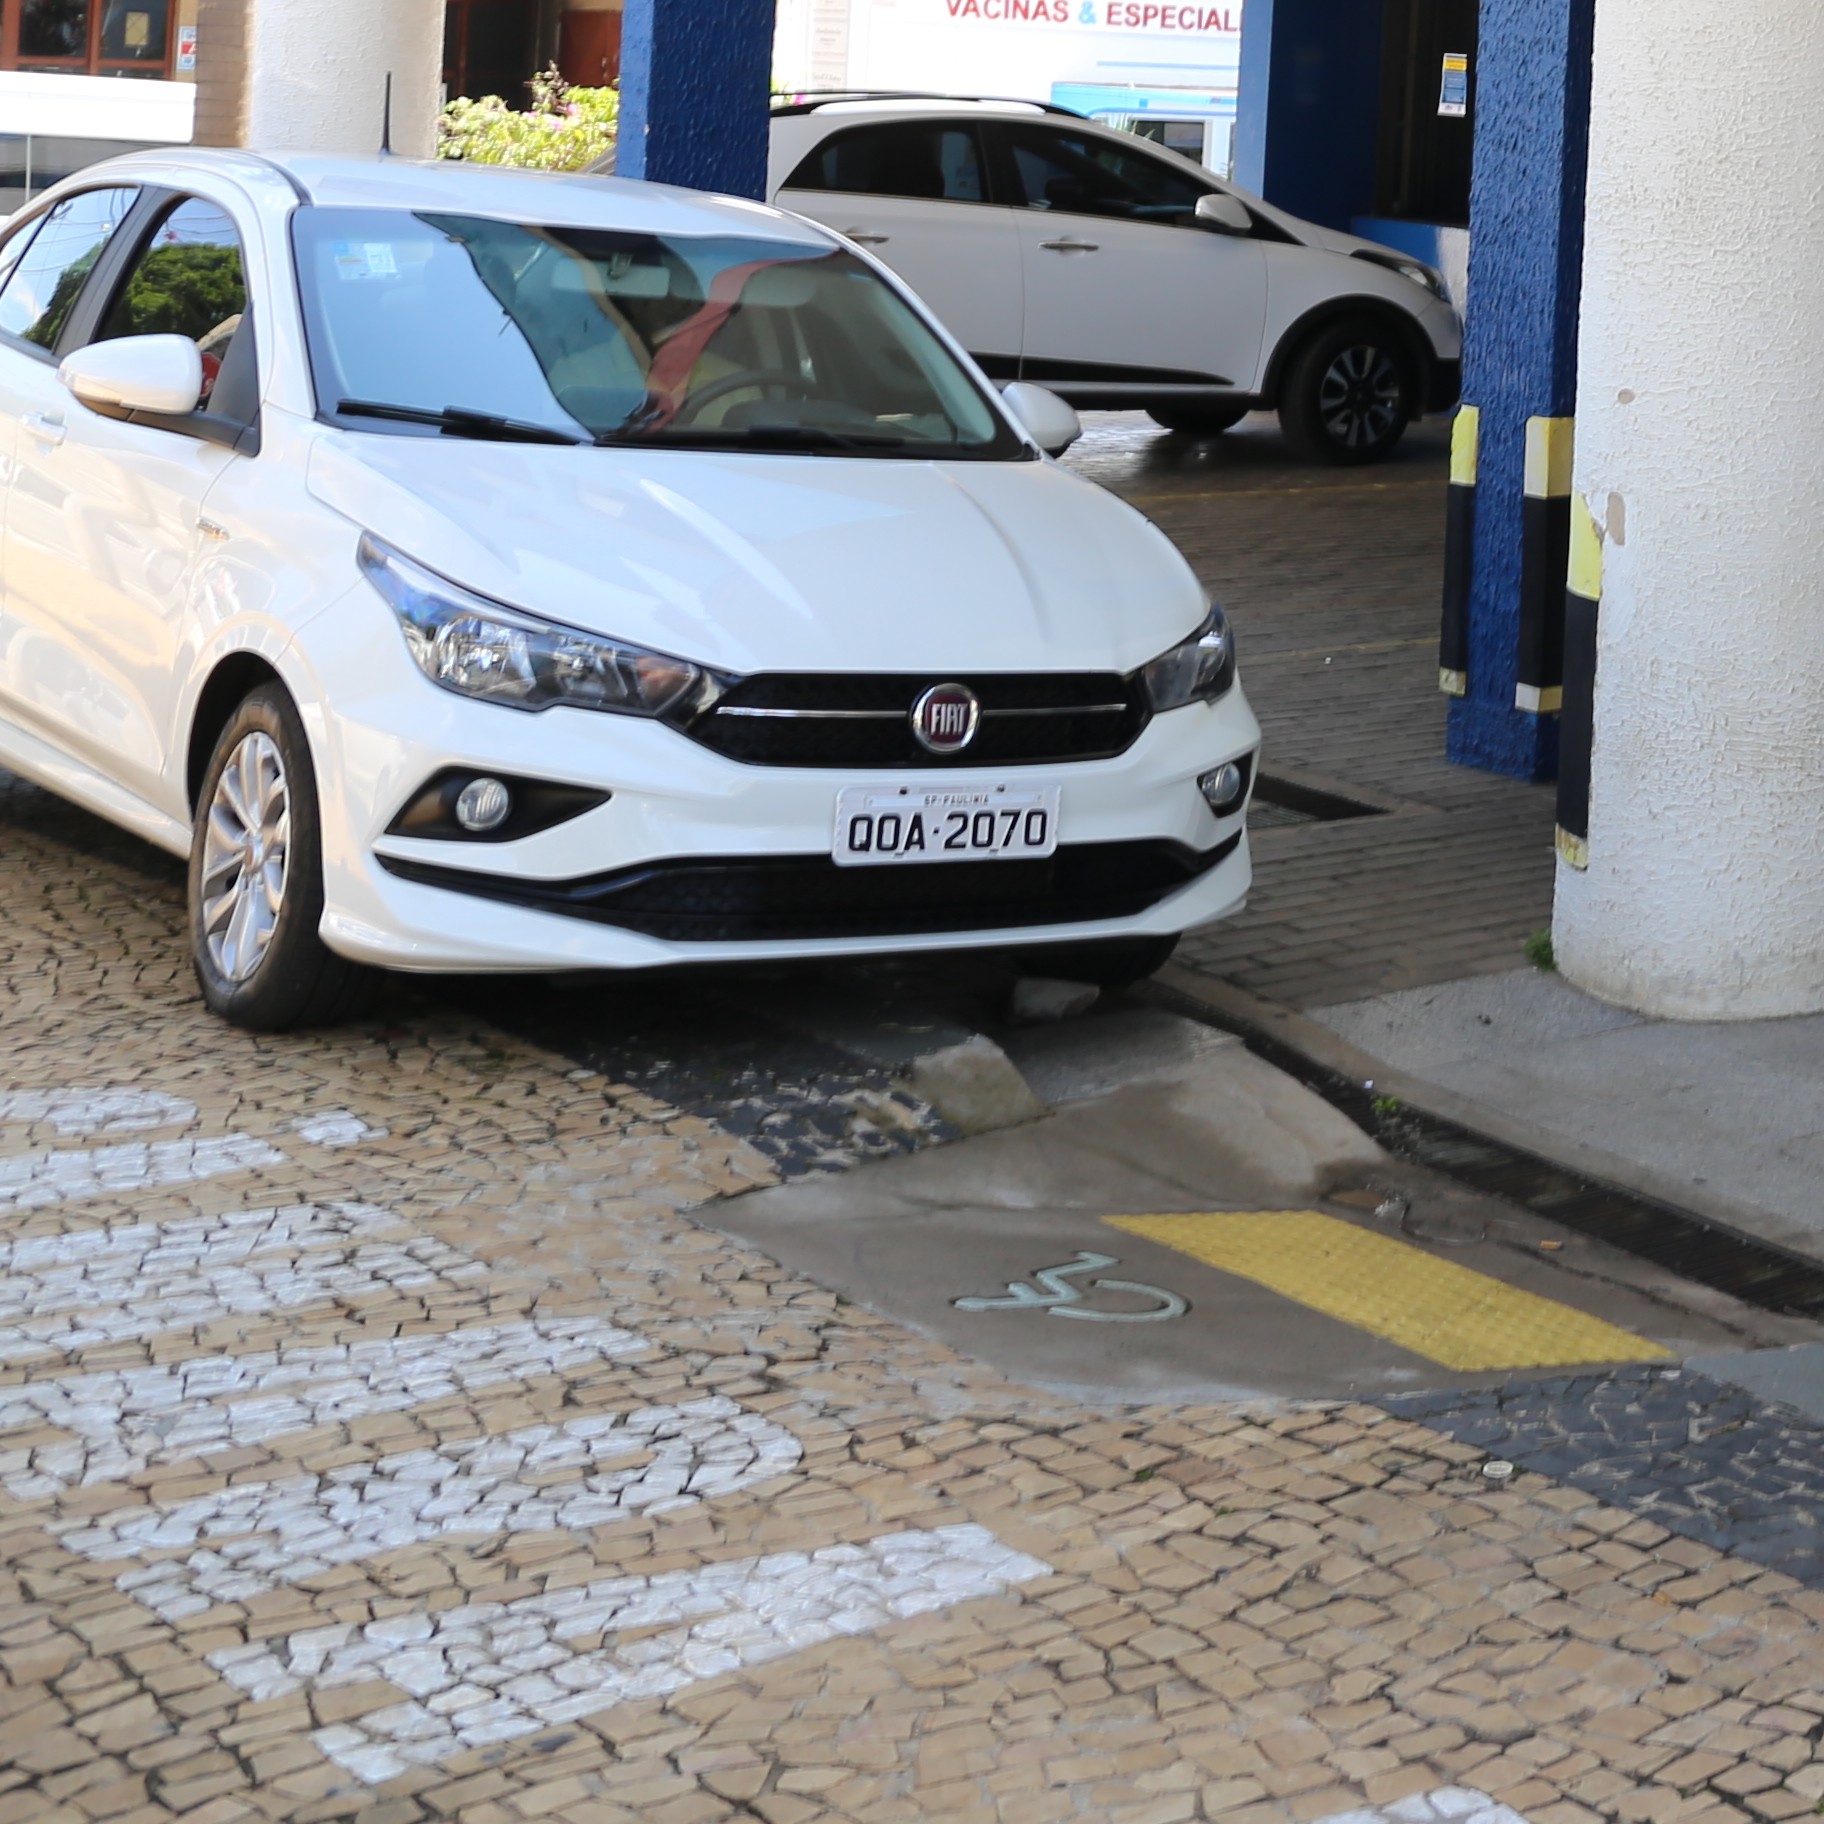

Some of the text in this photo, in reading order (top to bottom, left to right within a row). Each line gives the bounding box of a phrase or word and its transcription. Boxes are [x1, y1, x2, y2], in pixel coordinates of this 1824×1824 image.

[1078, 1, 1096, 24] &
[1106, 2, 1241, 32] ESPECIAL
[931, 704, 968, 735] FIAT
